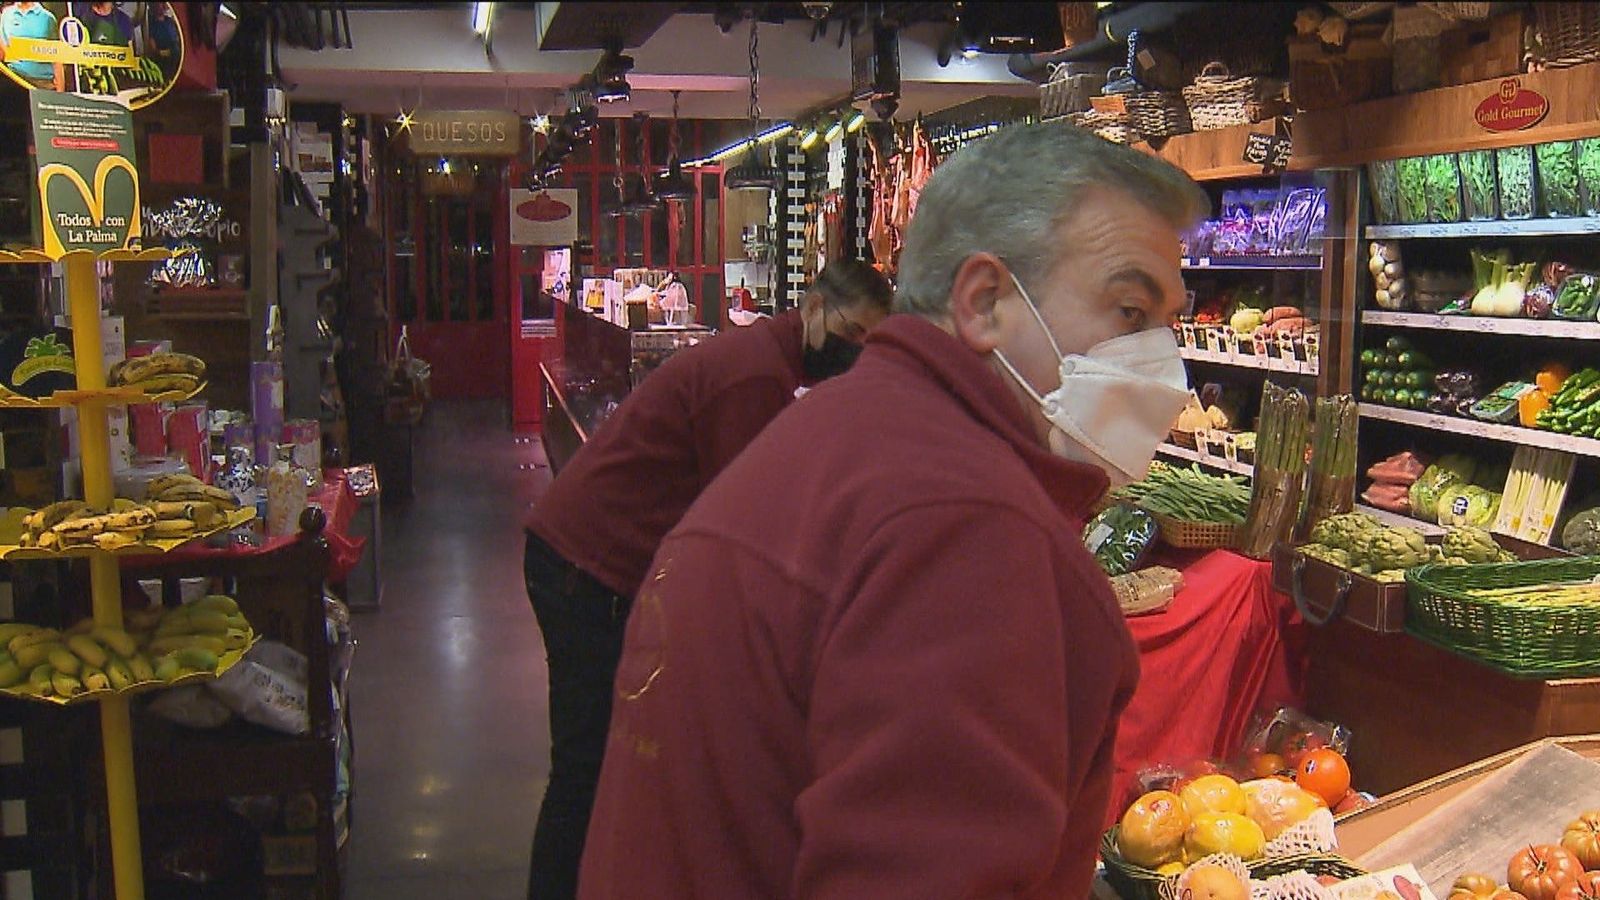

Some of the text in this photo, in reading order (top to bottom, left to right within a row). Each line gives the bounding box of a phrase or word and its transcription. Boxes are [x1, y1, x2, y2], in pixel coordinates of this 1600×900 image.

[1477, 104, 1543, 122] Gold Gourmet
[423, 121, 506, 142] QUESOS
[57, 213, 126, 227] Todos con
[68, 230, 117, 243] La Palma
